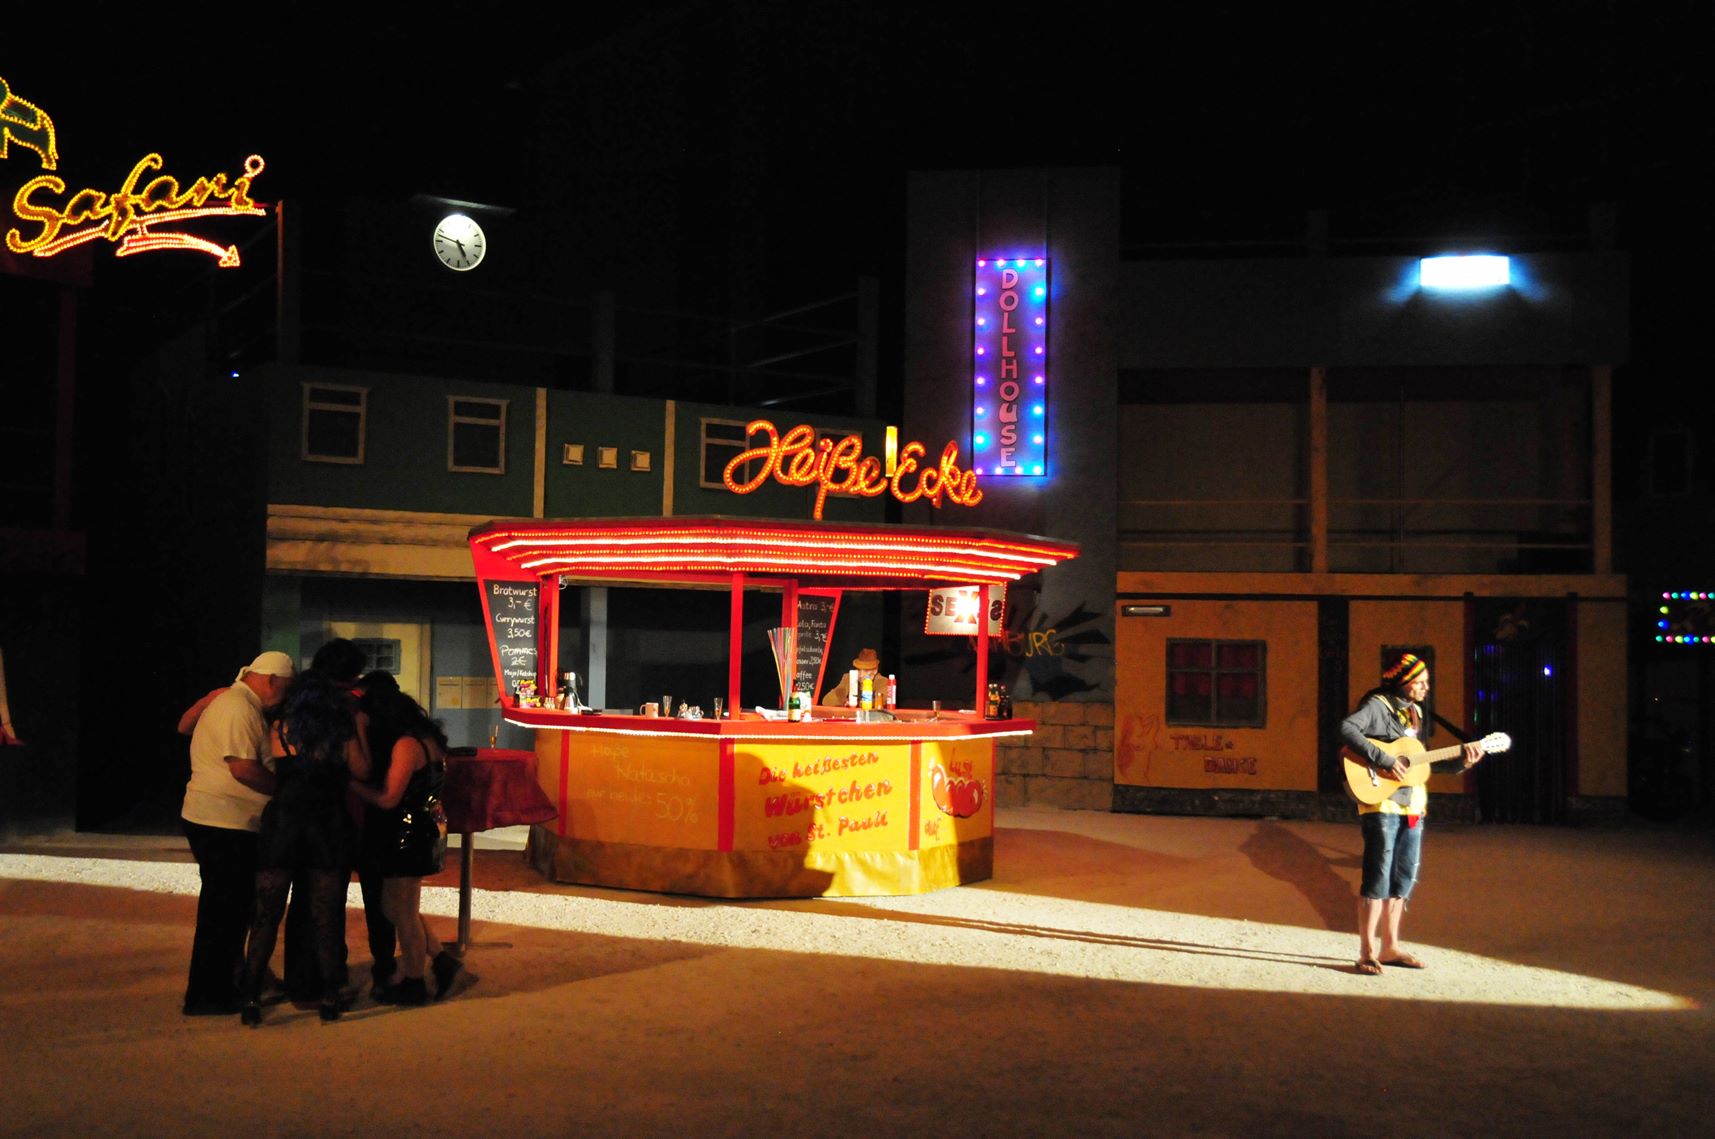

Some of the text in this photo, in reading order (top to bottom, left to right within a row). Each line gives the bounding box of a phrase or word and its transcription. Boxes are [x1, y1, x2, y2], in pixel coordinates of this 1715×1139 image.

[6, 153, 265, 253] Safari
[999, 268, 1020, 467] DOLLHOUSE
[723, 419, 983, 521] Heiße Ecke
[493, 584, 538, 597] Bratwurst
[495, 613, 536, 627] Currywurst
[500, 644, 538, 656] Pommes
[758, 752, 879, 785] Die heißesten
[655, 791, 699, 823] 50%
[765, 780, 892, 818] Würstchen
[768, 831, 801, 849] von
[838, 811, 888, 836] Pauli
